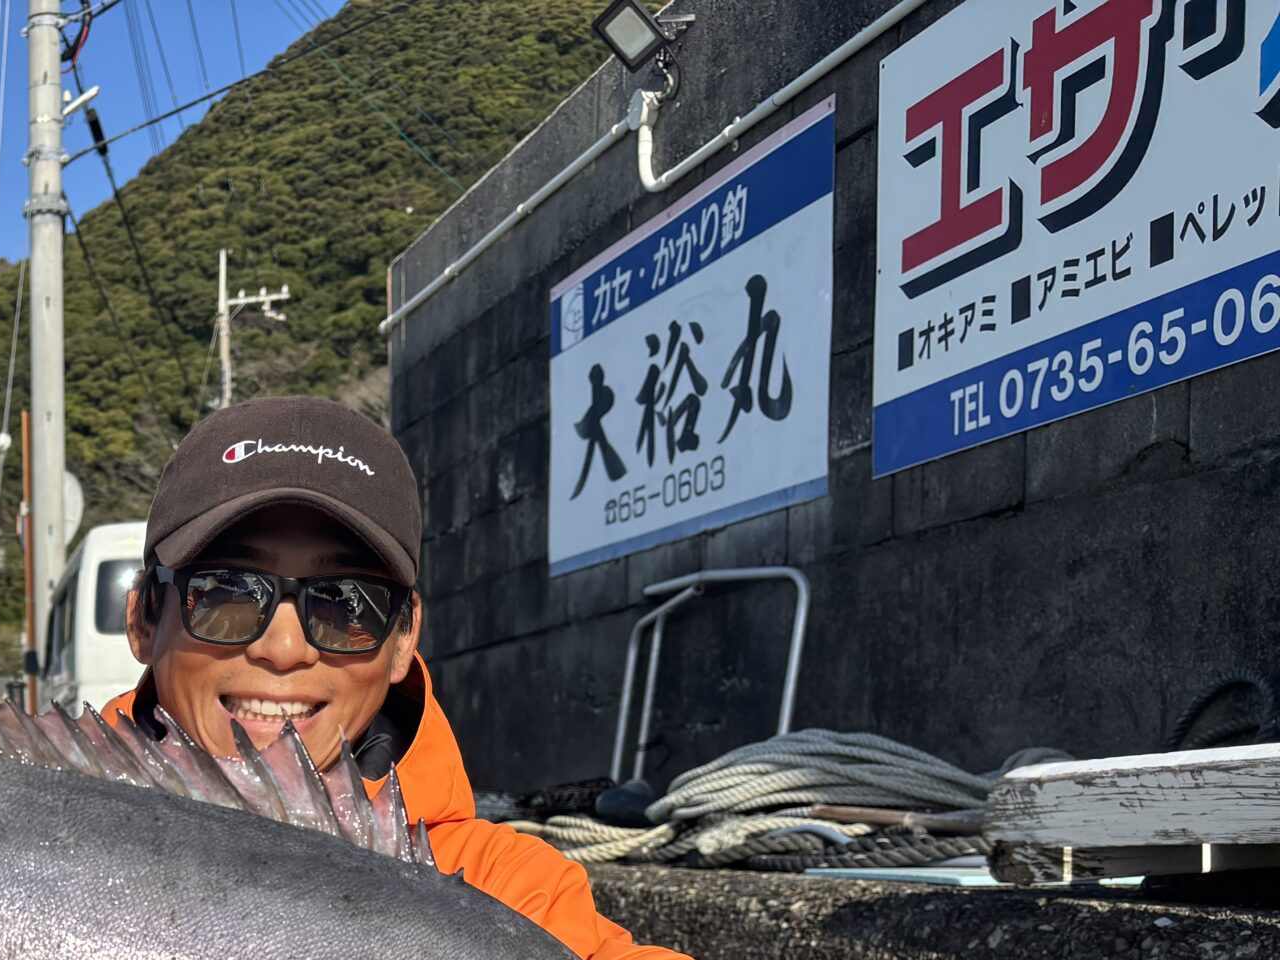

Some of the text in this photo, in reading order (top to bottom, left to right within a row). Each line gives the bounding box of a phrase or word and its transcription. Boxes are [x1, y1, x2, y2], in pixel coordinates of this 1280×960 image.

[592, 184, 749, 326] カセ・かかり釣
[918, 178, 1280, 360] オキアミ アミエビ ペレッ
[570, 274, 793, 501] 大裕丸
[950, 273, 1280, 436] TEL 0735-65-06
[222, 438, 375, 476] Champion
